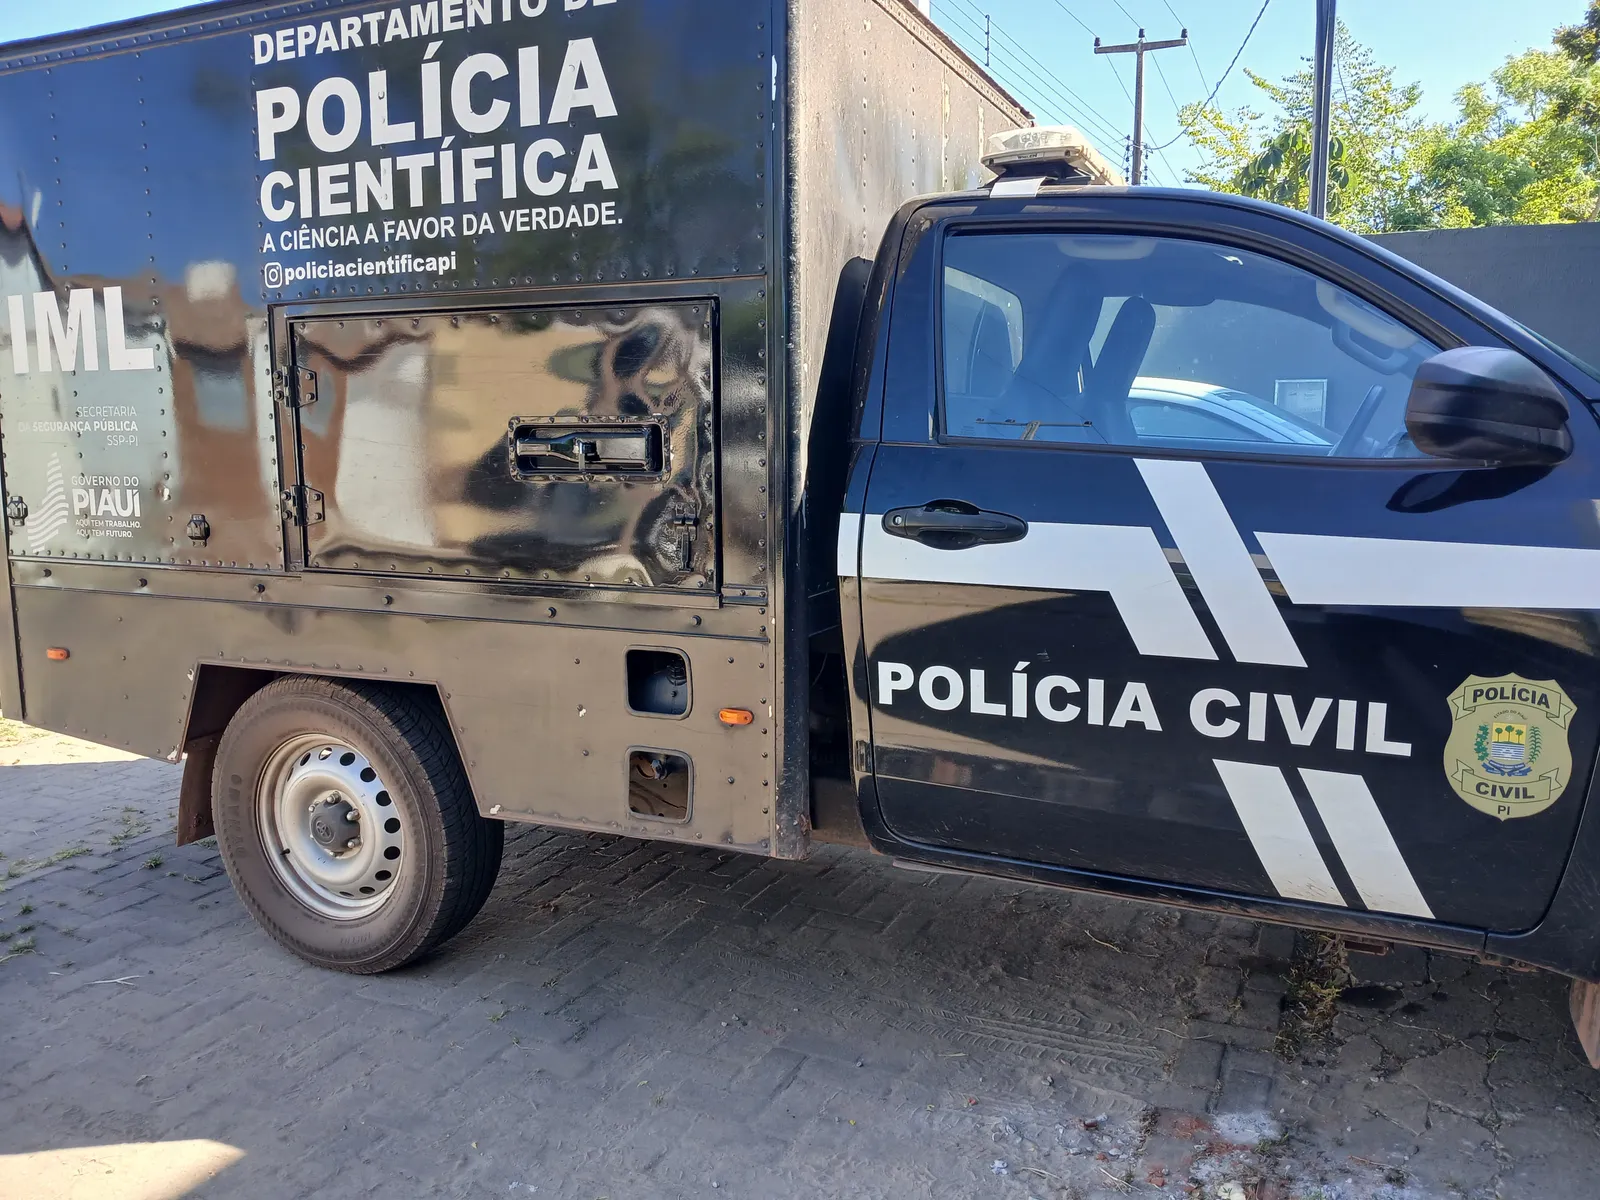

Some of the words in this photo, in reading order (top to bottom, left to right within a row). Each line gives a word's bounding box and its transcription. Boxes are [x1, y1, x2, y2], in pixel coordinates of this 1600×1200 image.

[253, 0, 548, 65] DEPARTAMENTO
[256, 37, 618, 161] POLÍCIA
[260, 133, 619, 222] CIENTÍFICA
[263, 233, 276, 252] A
[280, 224, 360, 251] CIÊNCIA
[364, 223, 379, 244] A
[384, 216, 456, 242] FAVOR
[463, 212, 494, 236] DA
[500, 201, 623, 232] VERDADE.
[284, 251, 457, 285] policiacientificapi
[7, 286, 155, 374] IML
[76, 406, 138, 417] SECRETARIA
[32, 421, 91, 434] SEGURANÇA
[93, 418, 139, 432] PÚBLICA
[107, 435, 139, 446] SSP-PI
[71, 476, 120, 486] GOVERNO
[124, 476, 139, 486] DO
[72, 488, 141, 517] PIAUÍ
[91, 519, 104, 527] TEM
[105, 520, 142, 529] TRABALHO.
[92, 529, 104, 537] TEM
[106, 530, 134, 538] FUTURO.
[877, 661, 1163, 731] POLÍCIA
[1189, 688, 1412, 757] CIVIL
[1472, 684, 1550, 709] POLÍCIA
[1475, 782, 1535, 799] CIVIL
[1497, 805, 1511, 815] PI
